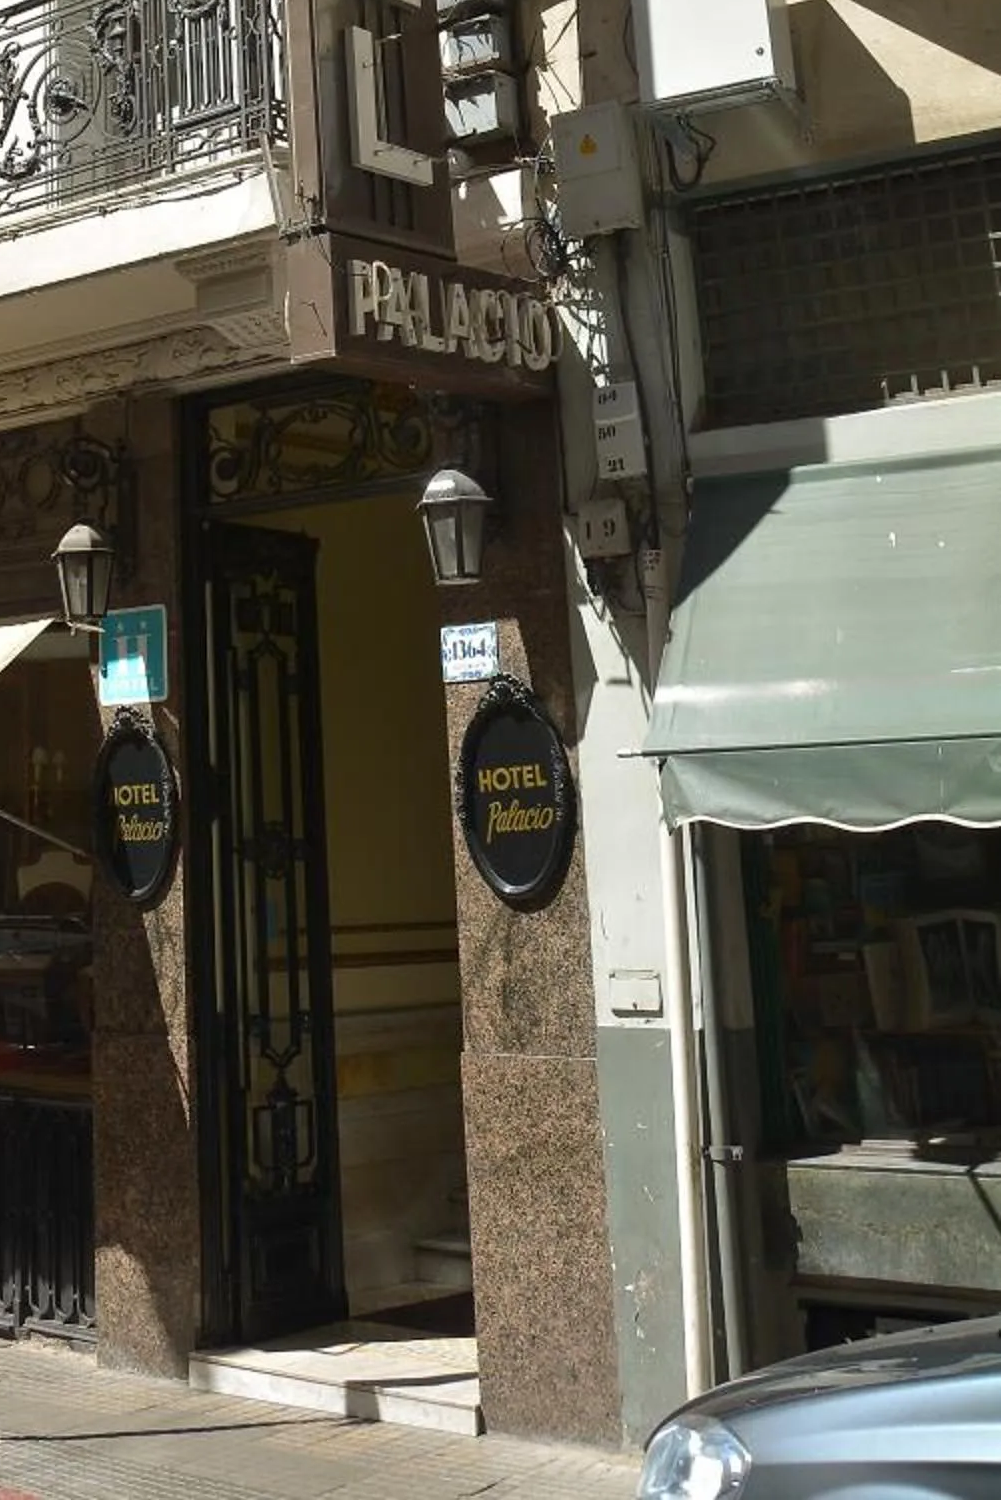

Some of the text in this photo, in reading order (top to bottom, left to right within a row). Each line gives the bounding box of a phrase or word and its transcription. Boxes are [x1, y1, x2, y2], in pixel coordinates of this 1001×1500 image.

[346, 258, 561, 372] PALACIO
[452, 637, 487, 661] 1364
[478, 764, 548, 793] HOTEL
[486, 799, 554, 845] Palacio
